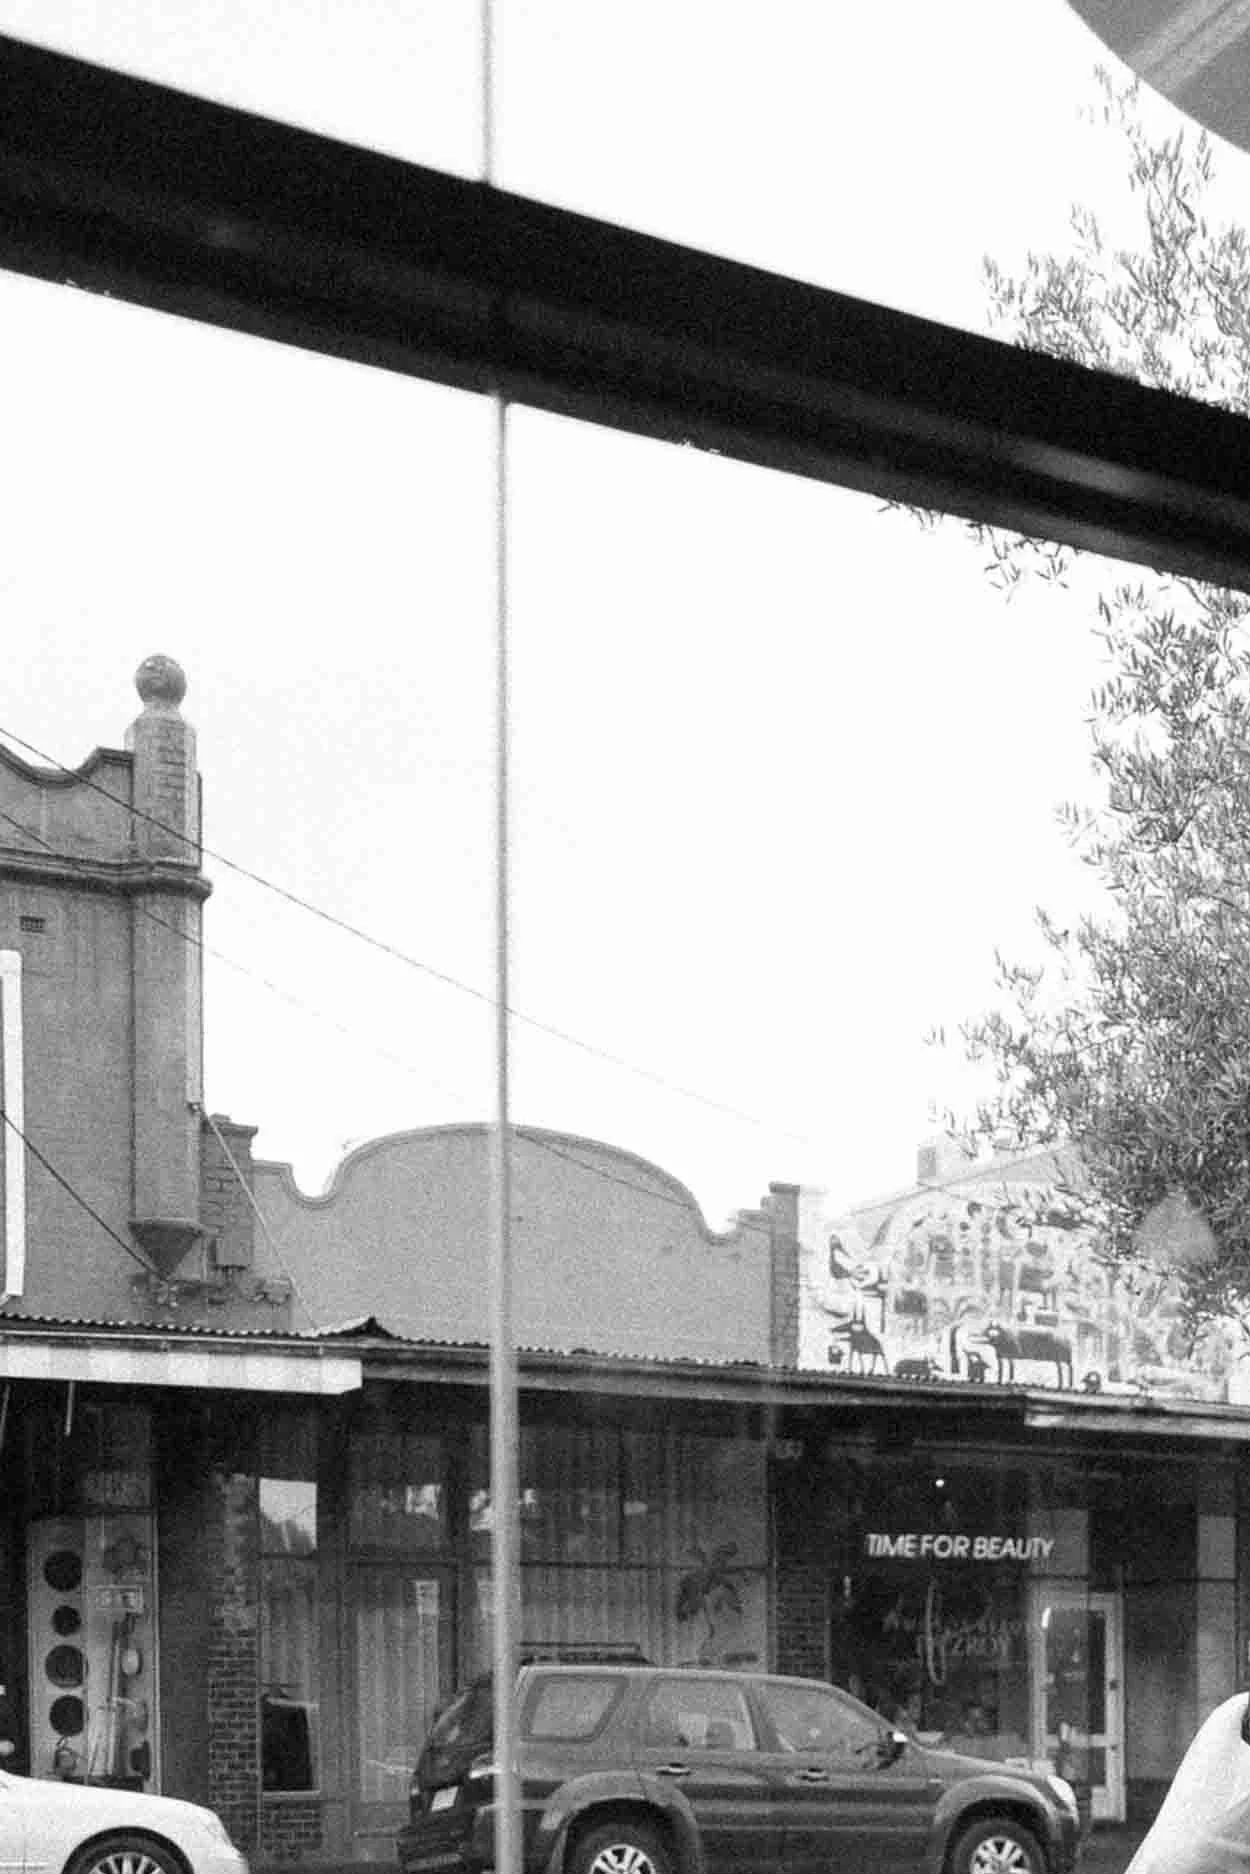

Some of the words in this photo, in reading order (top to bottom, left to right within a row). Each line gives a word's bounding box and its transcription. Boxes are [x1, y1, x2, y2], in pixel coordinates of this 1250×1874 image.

[867, 1533, 919, 1558] TIME
[919, 1534, 971, 1559] FOR
[972, 1535, 1055, 1560] BEAUTY
